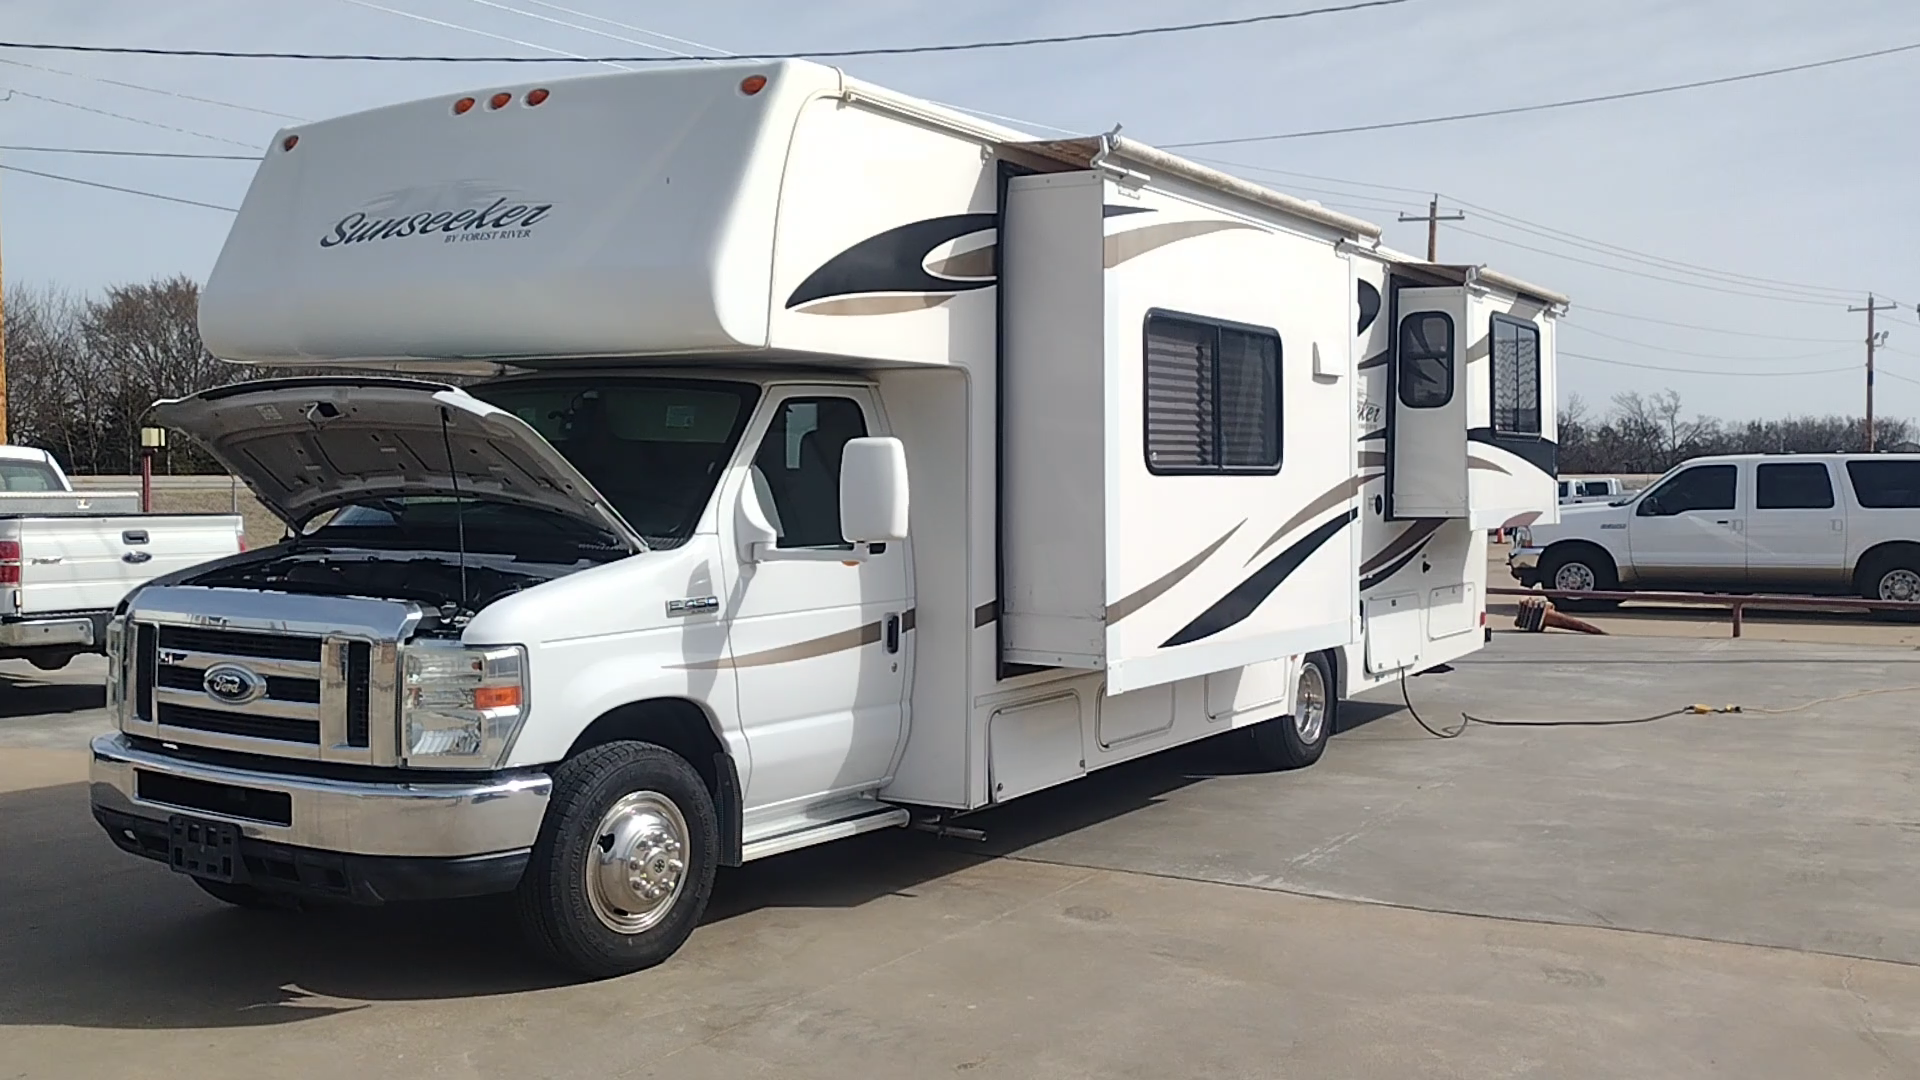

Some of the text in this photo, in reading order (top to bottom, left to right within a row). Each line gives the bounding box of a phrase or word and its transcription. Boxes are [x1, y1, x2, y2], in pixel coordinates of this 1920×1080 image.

[320, 197, 553, 247] Sunseeker
[444, 229, 532, 243] BY FOREST RIVER
[213, 674, 241, 693] Ford
